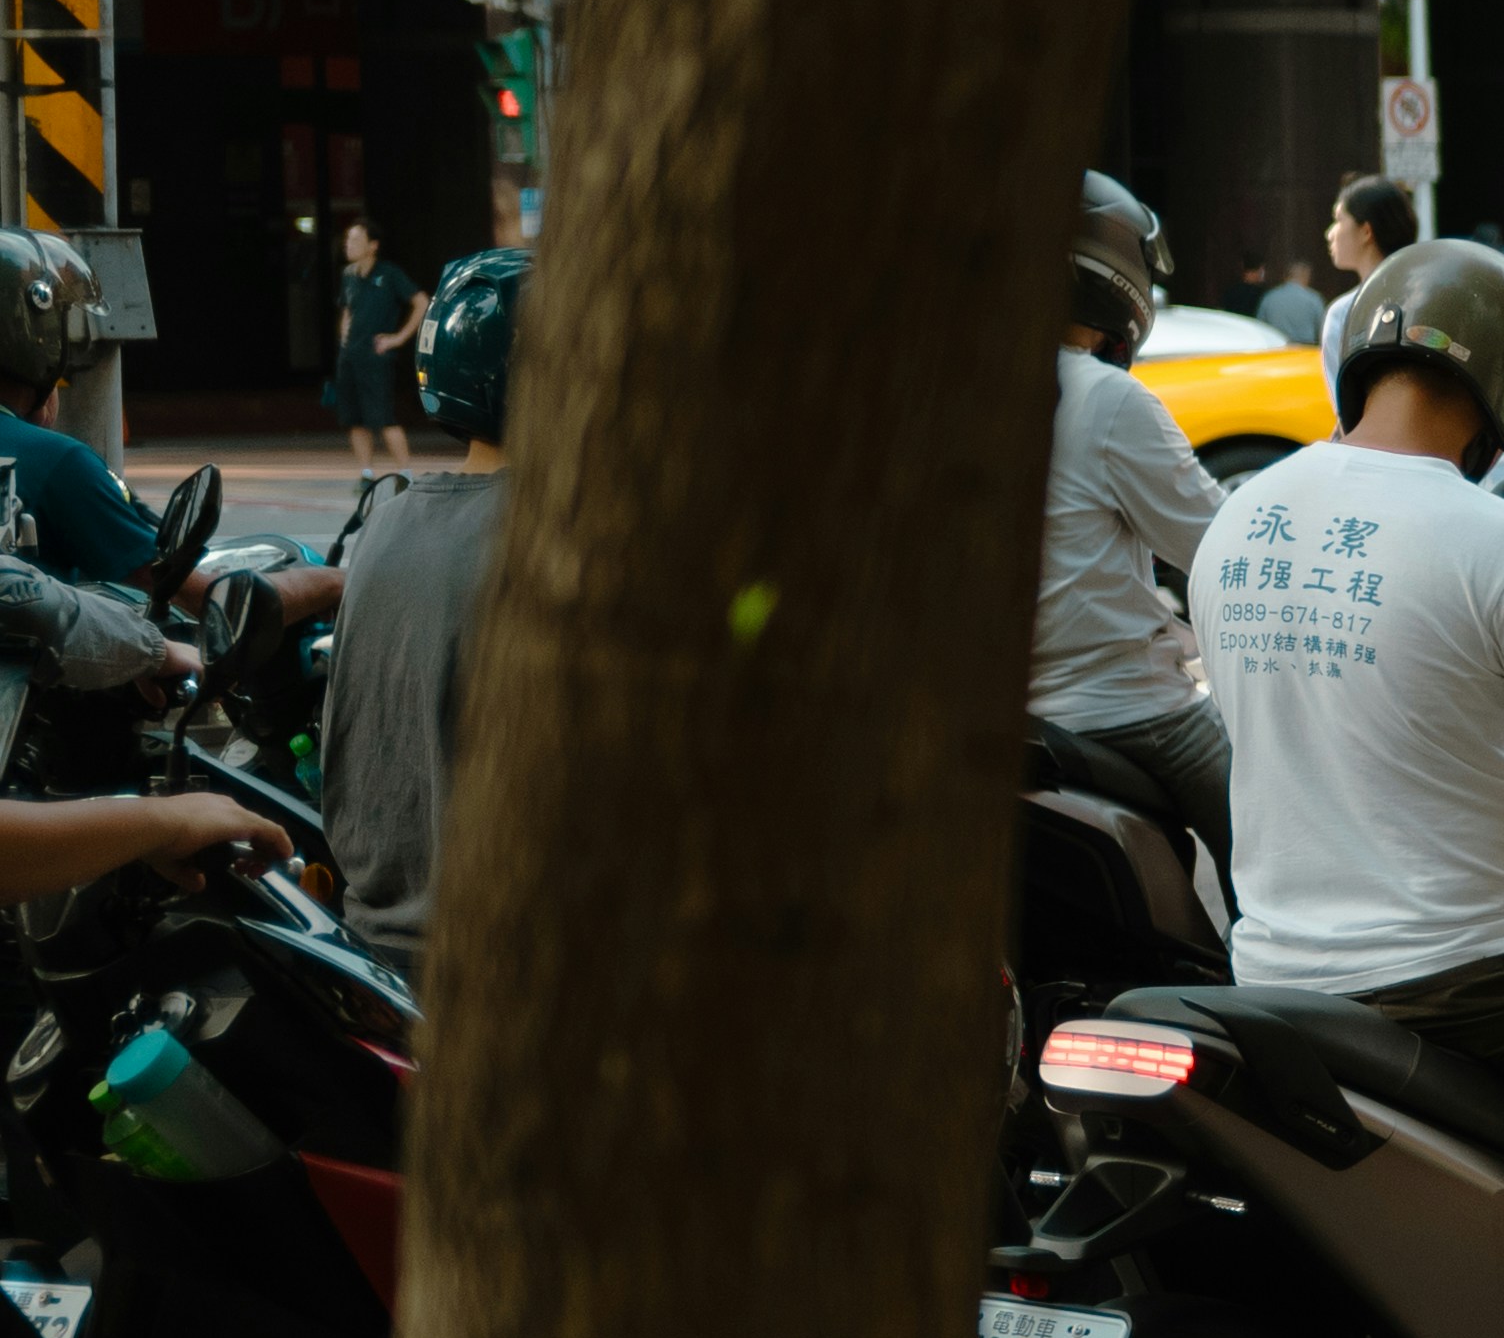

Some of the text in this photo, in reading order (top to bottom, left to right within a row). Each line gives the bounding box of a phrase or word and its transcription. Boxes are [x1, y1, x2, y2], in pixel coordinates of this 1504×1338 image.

[1222, 603, 1372, 635] 0989-674-817
[993, 1311, 1057, 1338] 電動車
